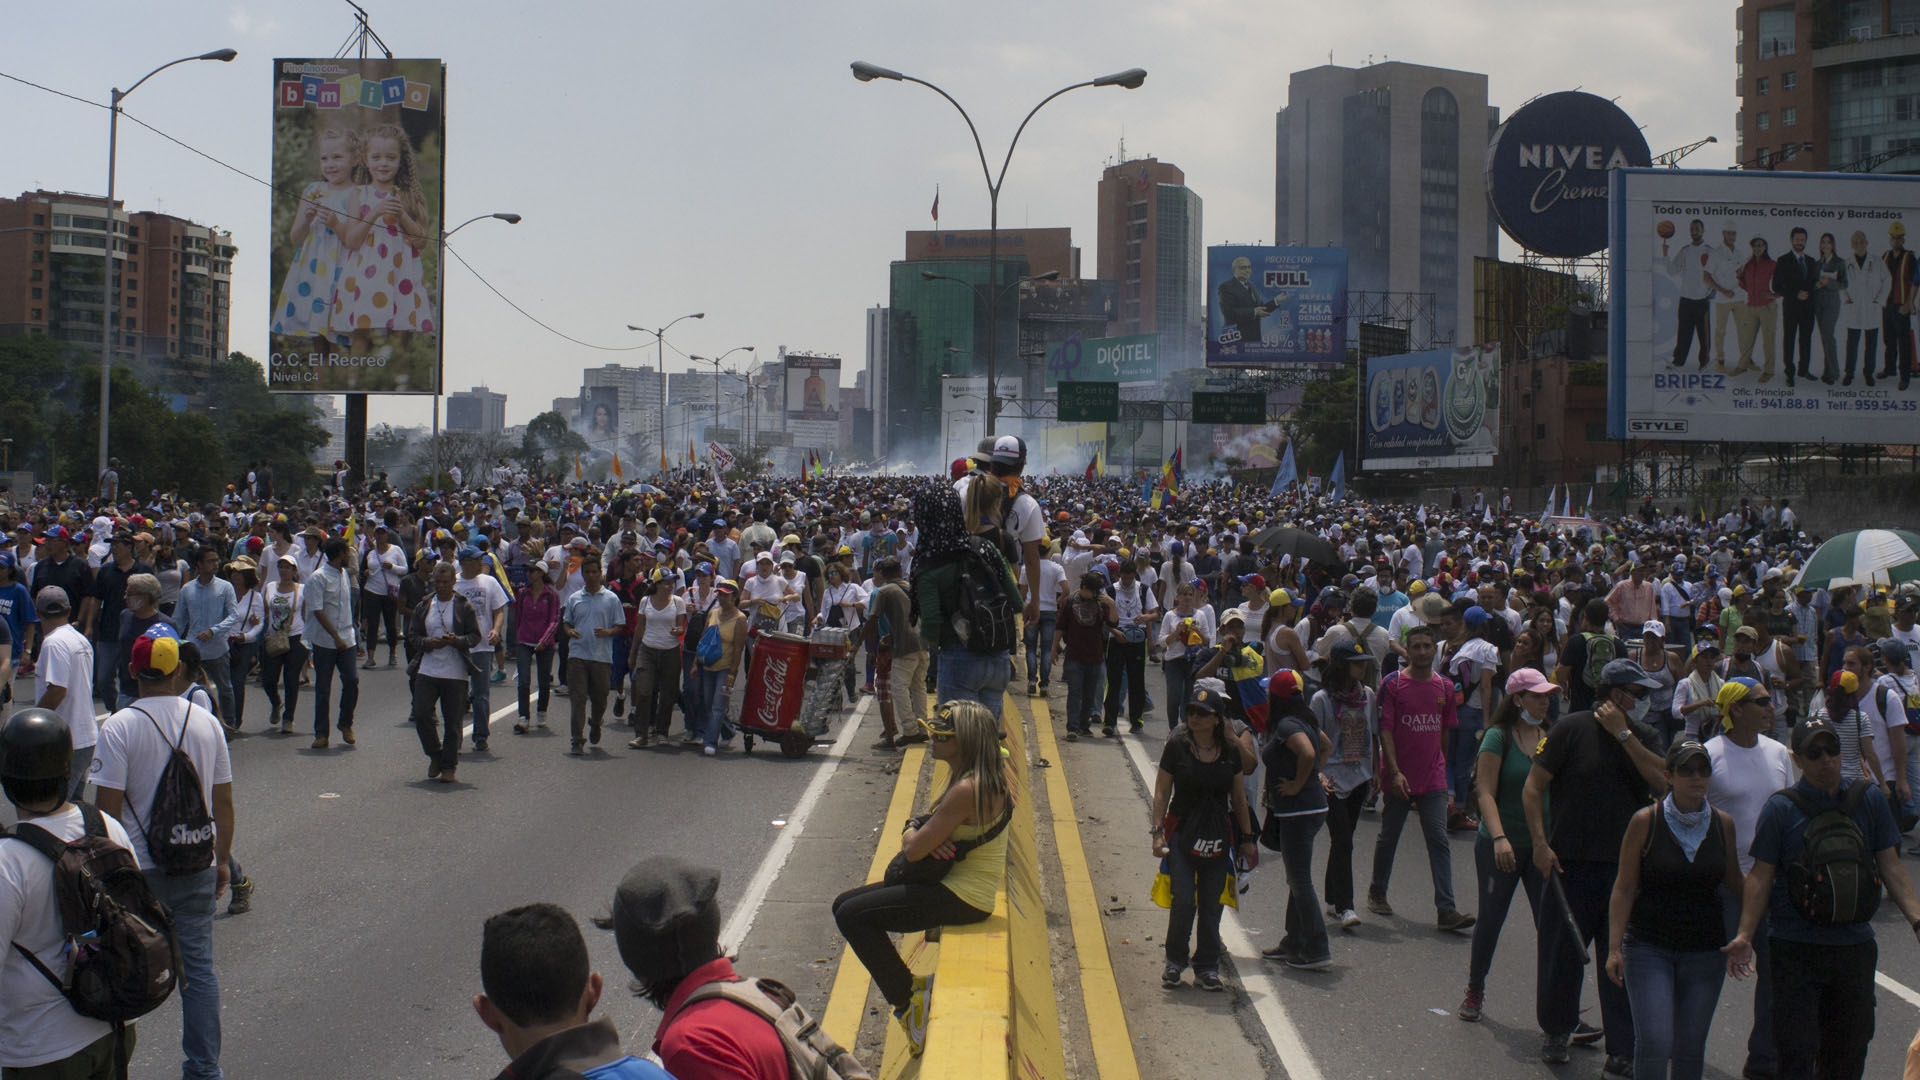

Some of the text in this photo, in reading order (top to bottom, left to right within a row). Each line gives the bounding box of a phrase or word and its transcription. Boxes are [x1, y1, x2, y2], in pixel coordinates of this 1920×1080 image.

[284, 79, 427, 107] bambino
[1519, 142, 1630, 170] NIVEA
[1529, 168, 1609, 213] Creme
[1653, 205, 1903, 220] Todo en Uniformes, Confección y Bordados
[1265, 256, 1313, 264] PROTECTOR
[1263, 271, 1311, 288] FULL
[1299, 304, 1333, 314] ZIKA
[1262, 334, 1294, 348] 99%
[270, 353, 386, 367] C.C. El Recreo
[273, 372, 319, 382] Nivel C4
[1654, 374, 1726, 389] BRIPEZ
[1755, 388, 1795, 399] Principal
[1827, 389, 1857, 398] Tienda
[1761, 399, 1820, 409] 941.88.81
[1855, 400, 1918, 411] 959.54.35
[1631, 422, 1685, 431] STYLE
[757, 653, 789, 726] Coca-Cola
[1401, 713, 1442, 727] QATAR
[1193, 838, 1223, 854] UFC
